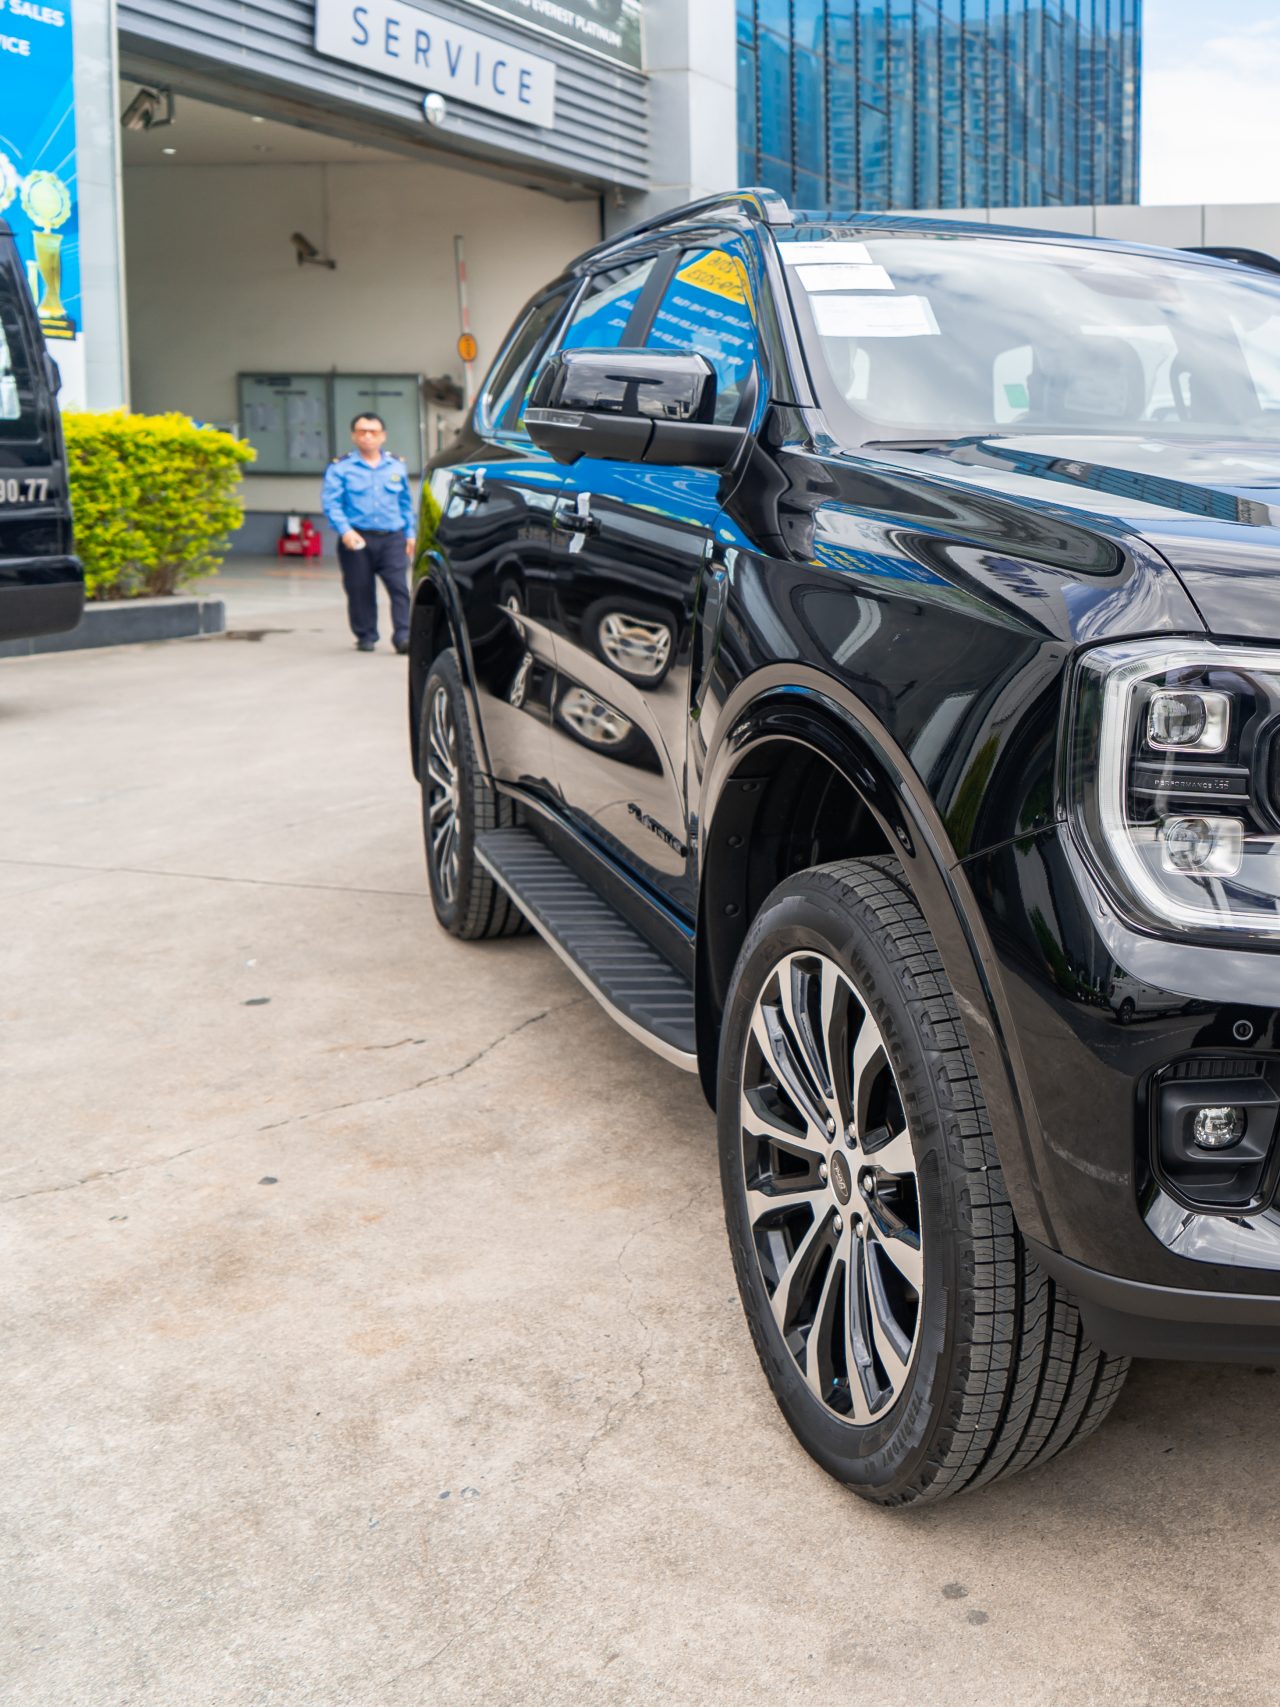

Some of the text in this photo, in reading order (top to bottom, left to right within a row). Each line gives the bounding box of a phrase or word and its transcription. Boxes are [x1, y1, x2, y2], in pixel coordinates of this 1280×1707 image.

[9, 0, 65, 28] SALES
[0, 34, 31, 57] ICE
[575, 14, 622, 48] PLATINUM
[351, 6, 532, 104] SERVICE
